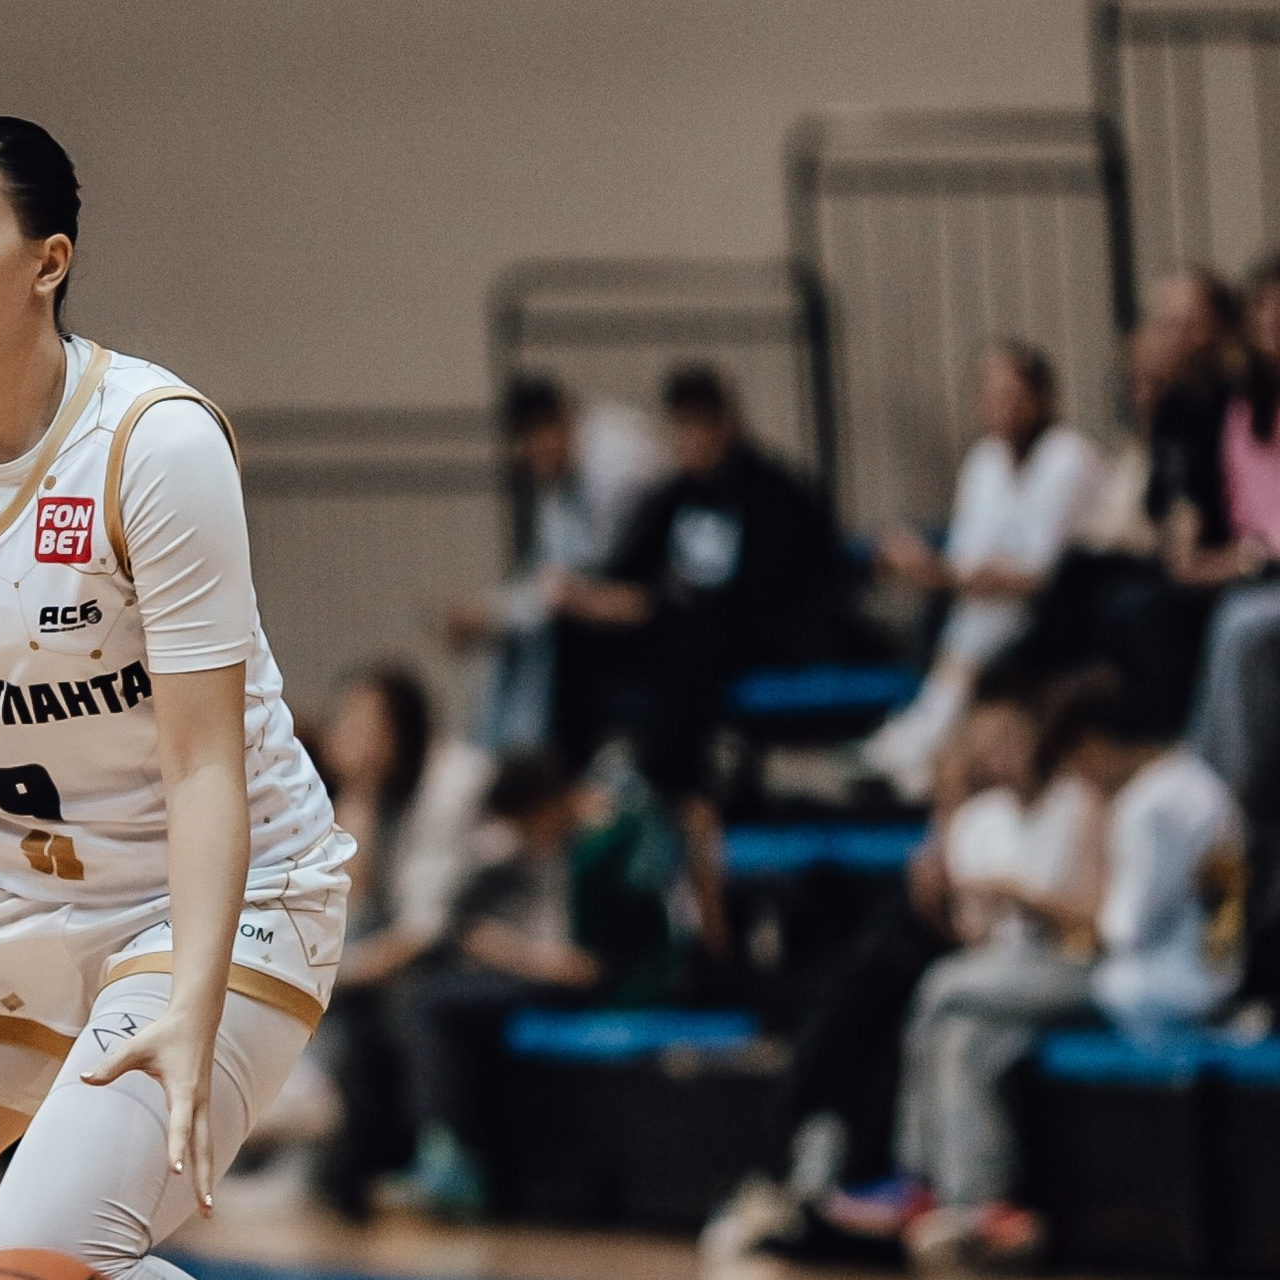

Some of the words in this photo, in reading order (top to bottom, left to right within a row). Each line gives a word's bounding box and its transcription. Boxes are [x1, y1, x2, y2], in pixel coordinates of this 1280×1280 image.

[39, 504, 93, 529] FON
[38, 529, 89, 556] BET
[240, 923, 275, 945] OM
